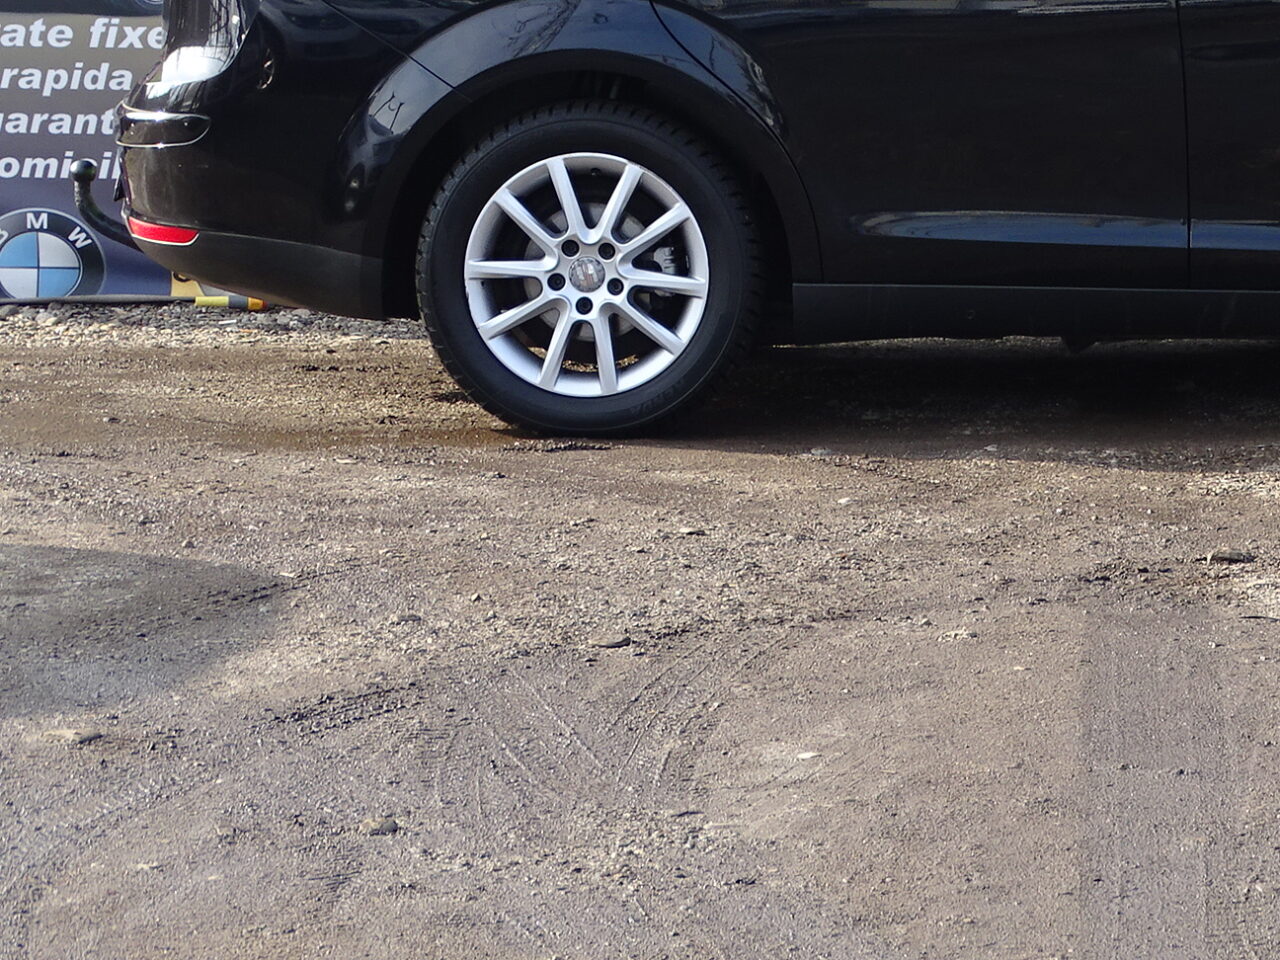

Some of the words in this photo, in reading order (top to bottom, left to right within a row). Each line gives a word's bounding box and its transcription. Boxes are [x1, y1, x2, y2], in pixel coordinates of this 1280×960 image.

[89, 17, 167, 49] fixe
[0, 62, 133, 97] rapida
[0, 108, 114, 136] arant
